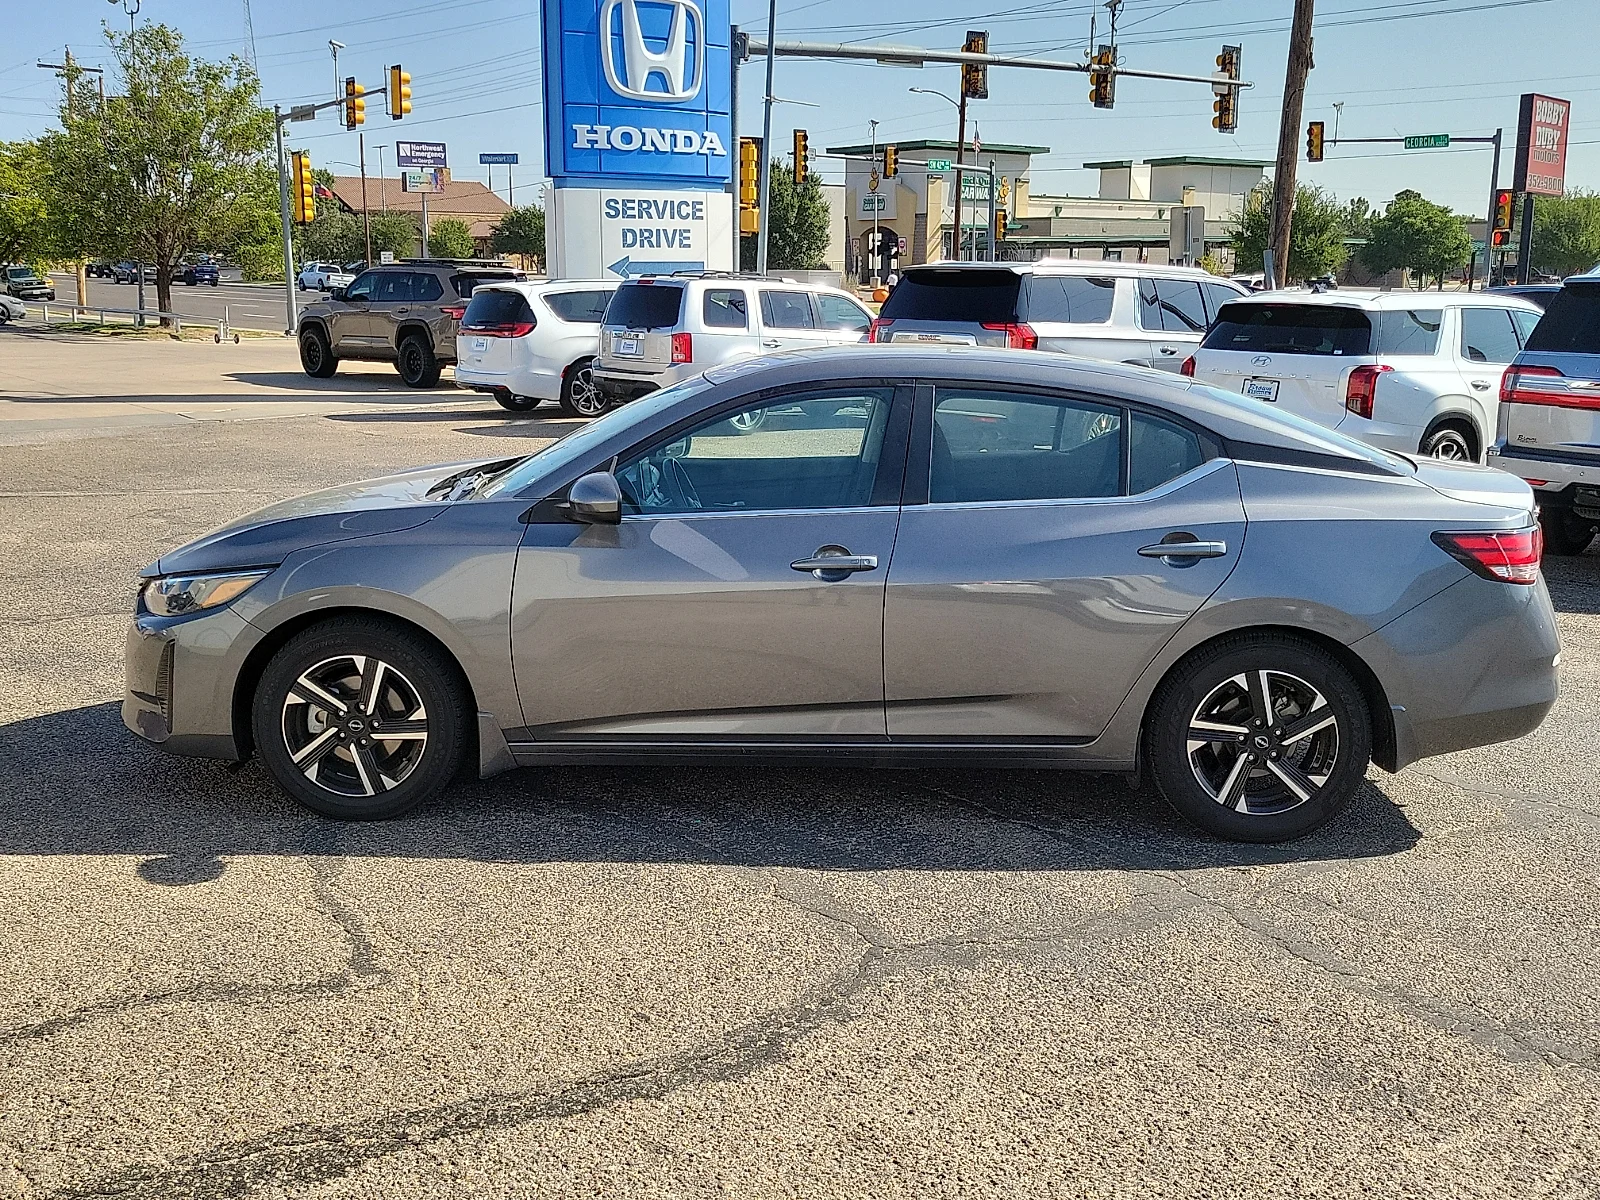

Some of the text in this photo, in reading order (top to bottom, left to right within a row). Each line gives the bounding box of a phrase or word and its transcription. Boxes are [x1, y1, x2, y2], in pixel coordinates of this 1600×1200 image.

[1535, 100, 1567, 127] BOBBY
[411, 144, 444, 152] Northwest
[572, 124, 727, 156] HONDA
[1405, 136, 1435, 148] GEORGIA
[1535, 126, 1560, 150] DUBY
[411, 151, 446, 159] Emergency
[1533, 150, 1560, 164] motors
[1527, 173, 1563, 192] 352-9800
[605, 199, 704, 220] SERVICE
[621, 228, 692, 249] DRIVE
